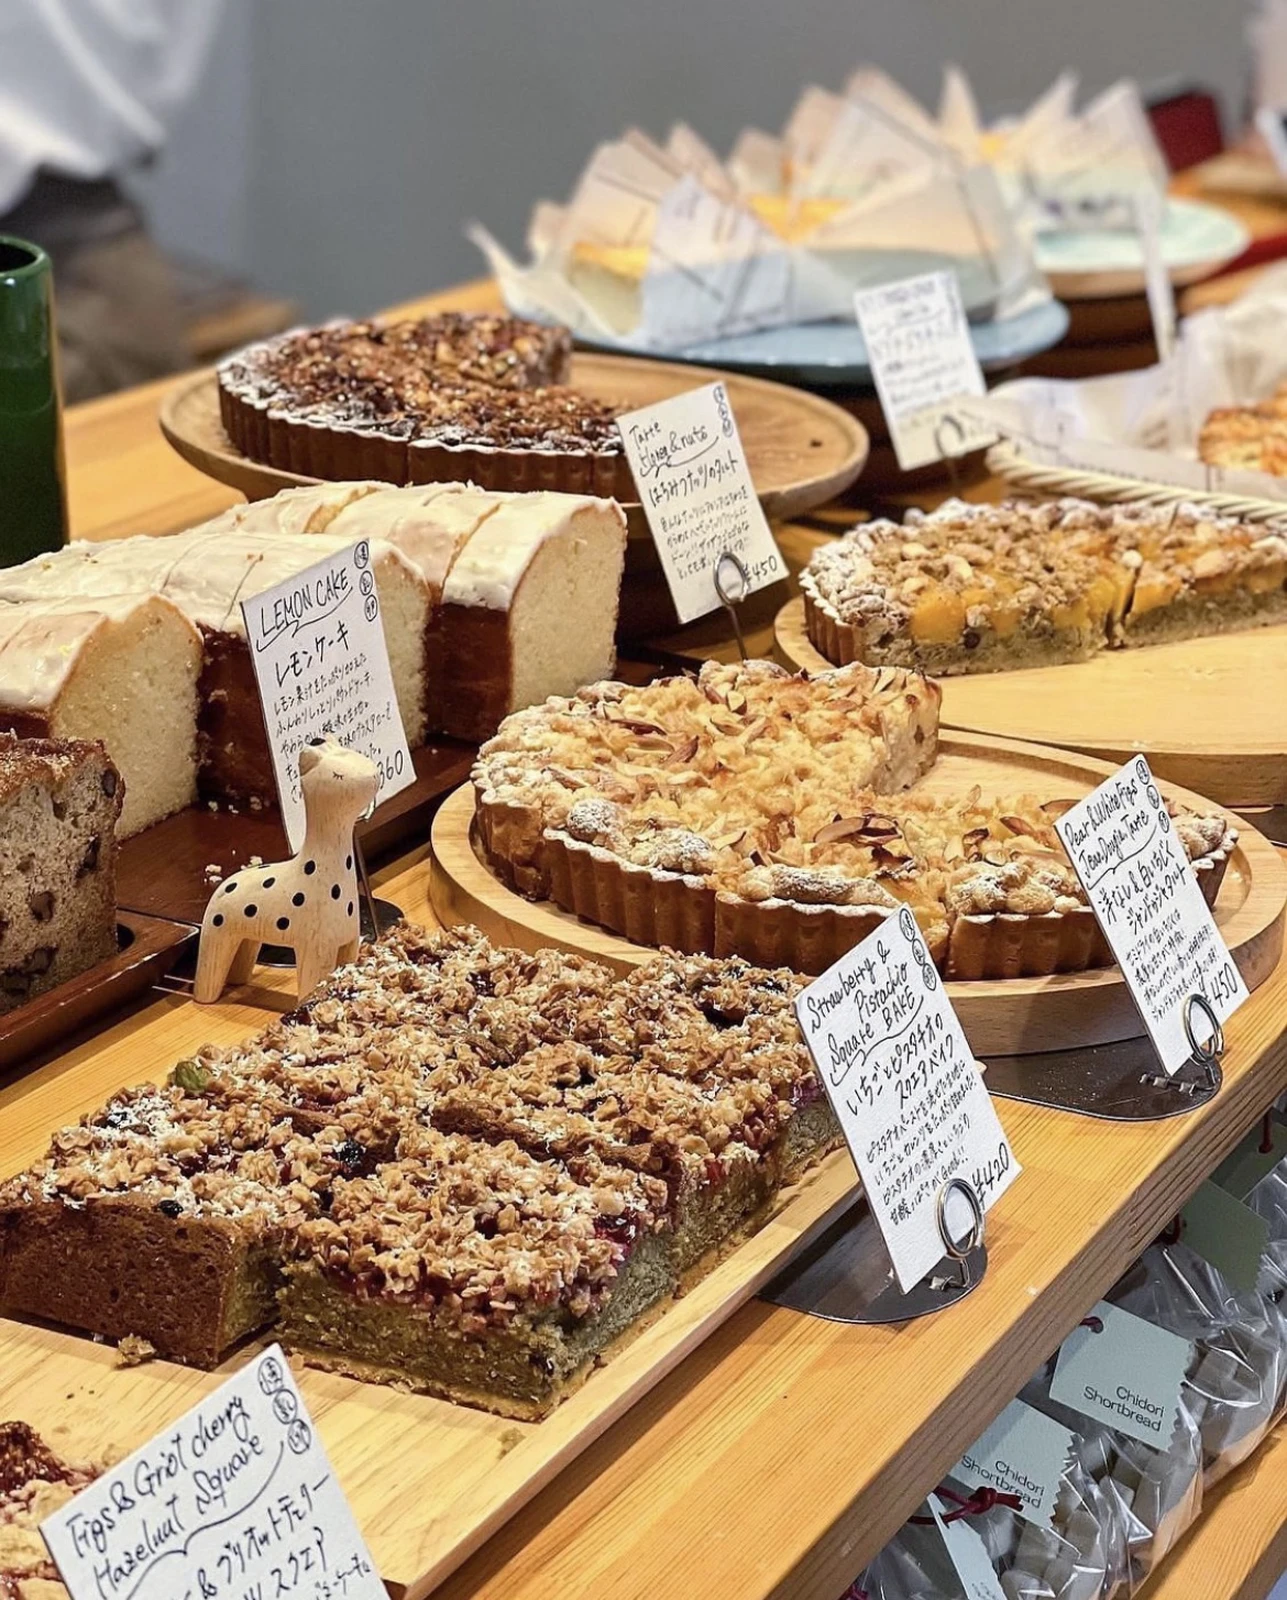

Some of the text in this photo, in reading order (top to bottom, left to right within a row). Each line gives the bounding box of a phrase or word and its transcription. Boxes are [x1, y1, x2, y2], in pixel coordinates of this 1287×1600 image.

[628, 421, 662, 451] Tarte
[669, 430, 682, 454] &
[680, 425, 708, 449] nuts
[260, 566, 349, 636] LEMON CAKE
[274, 619, 349, 689] レモンケーキ
[1127, 870, 1144, 894] &
[807, 939, 891, 1034] Strawberry &
[853, 961, 908, 1025] Pistachio
[1197, 961, 1239, 1009] ¥450
[829, 985, 916, 1073] Square BAKE
[845, 1012, 944, 1117] いちごとピスタチオの
[971, 1141, 1010, 1210] ¥420
[1083, 1385, 1162, 1433] Shortbread
[1115, 1385, 1165, 1418] Chidori
[65, 1506, 116, 1559] Figs
[109, 1480, 137, 1515] &
[191, 1395, 251, 1458] cherry
[995, 1460, 1045, 1497] Chidori
[93, 1434, 264, 1600] Hazelnut Square
